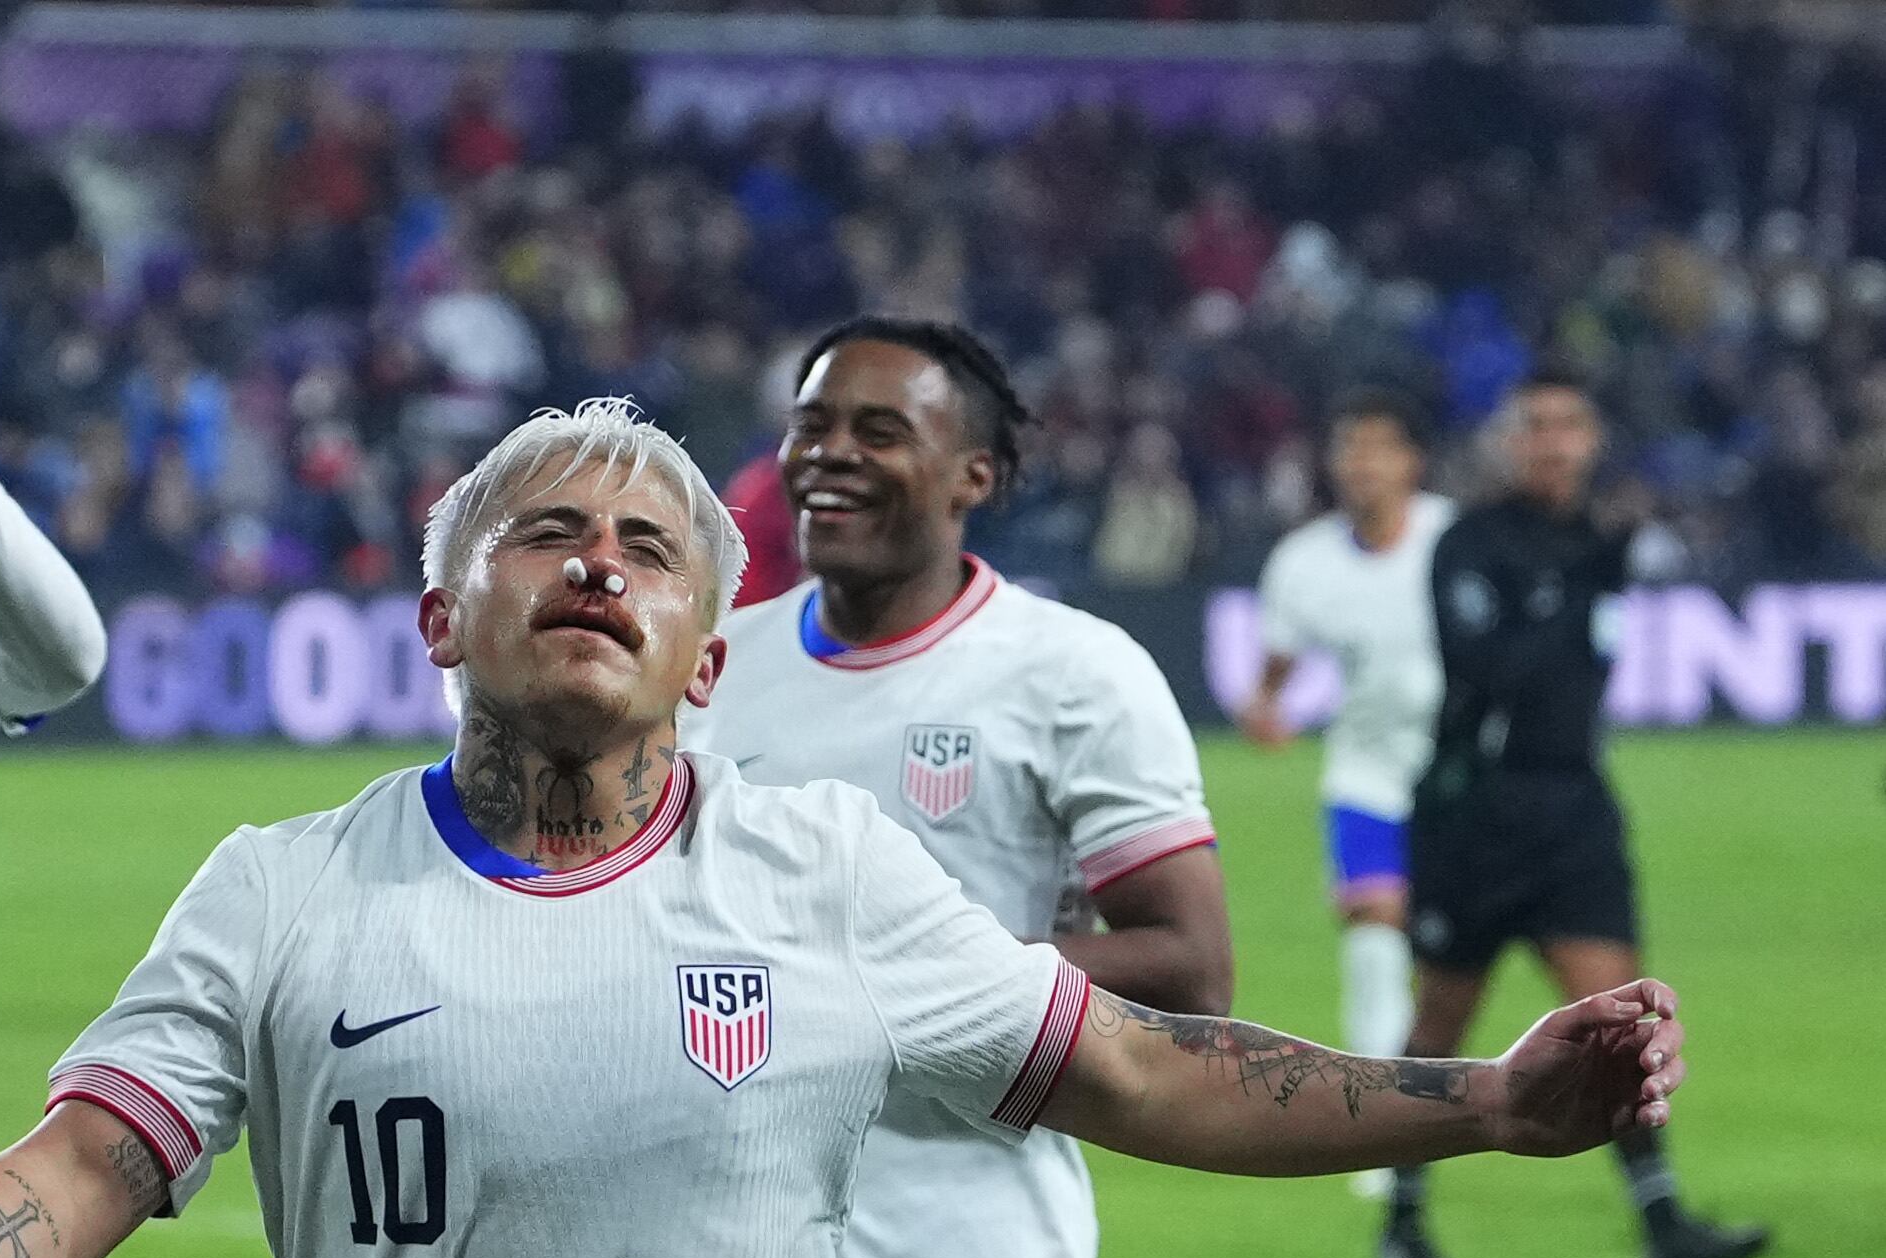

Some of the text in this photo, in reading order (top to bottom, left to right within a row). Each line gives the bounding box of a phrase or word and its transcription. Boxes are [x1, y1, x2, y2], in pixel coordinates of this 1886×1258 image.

[912, 733, 971, 766] USA
[685, 973, 764, 1017] USA
[328, 1096, 447, 1245] 10
